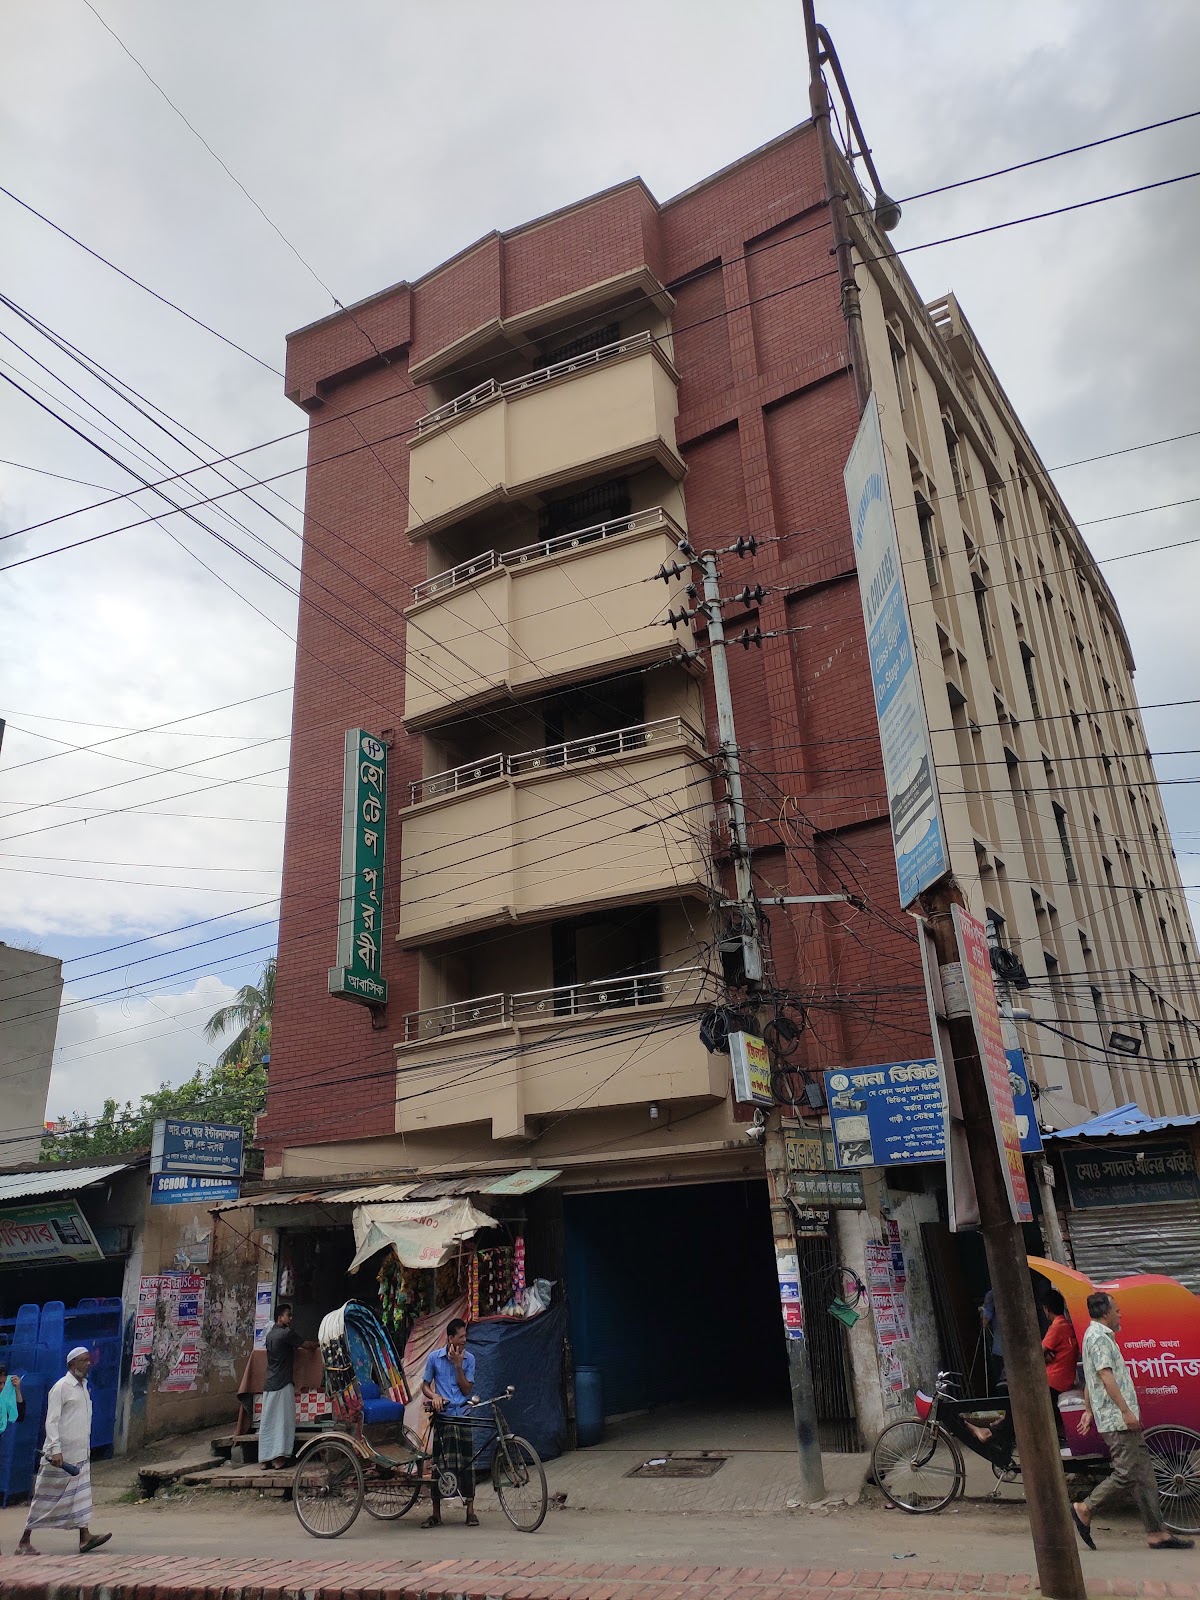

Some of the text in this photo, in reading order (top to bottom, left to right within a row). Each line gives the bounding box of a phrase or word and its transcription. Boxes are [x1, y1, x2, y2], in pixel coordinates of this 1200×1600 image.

[870, 546, 894, 615] COLLEGE
[876, 646, 889, 673] Class
[885, 659, 900, 688] Stage
[360, 761, 385, 857] হোটেল
[356, 868, 380, 972] পূরবী
[347, 974, 385, 997] আবাসিক
[850, 1071, 885, 1088] রানা
[878, 1088, 893, 1096] কোন
[1075, 1162, 1101, 1180] মোঃ
[1101, 1160, 1136, 1177] সাদাত
[158, 1176, 188, 1190] SCHOOL
[191, 1178, 197, 1188] &
[1124, 1339, 1180, 1349] কোয়ালিটি অথবা
[1145, 1385, 1178, 1395] কোয়ালিটি
